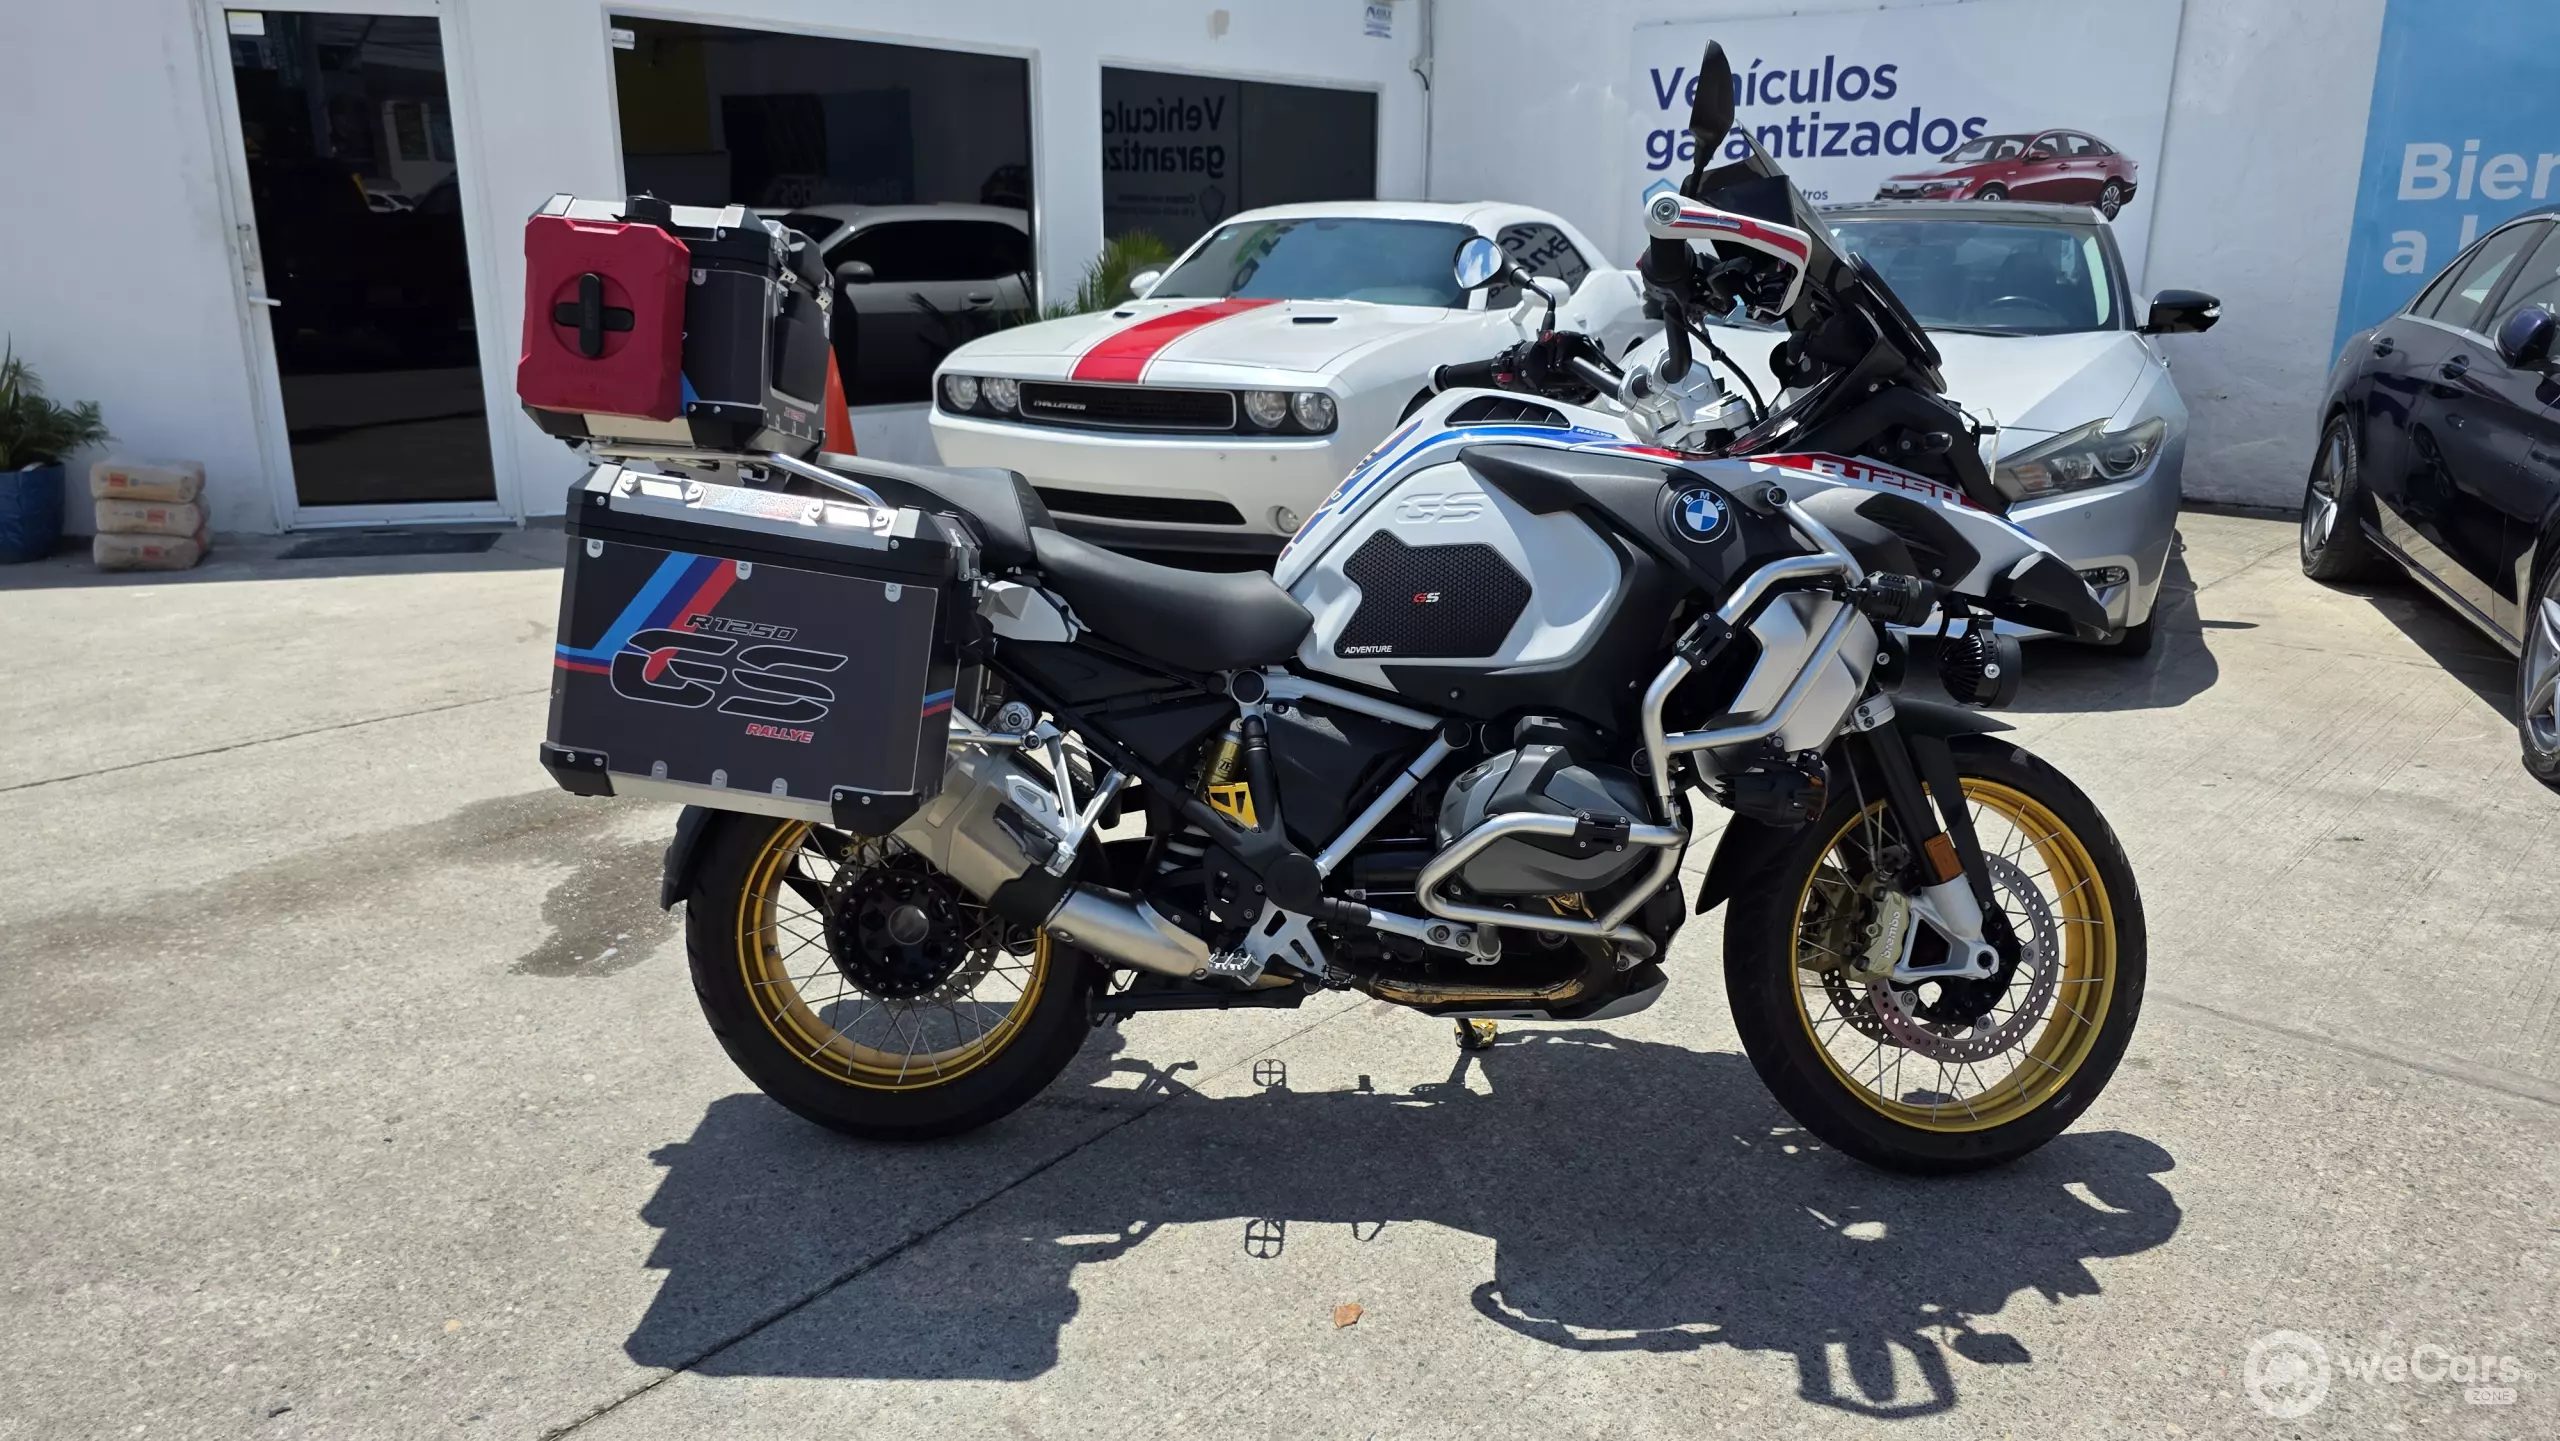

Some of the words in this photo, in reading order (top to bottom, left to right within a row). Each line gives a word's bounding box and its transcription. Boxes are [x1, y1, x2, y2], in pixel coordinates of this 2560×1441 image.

[1645, 106, 1988, 171] gaantizados
[1802, 189, 1829, 201] tros
[2382, 229, 2428, 275] a
[1395, 491, 1487, 525] GS
[1682, 491, 1727, 511] BMW
[1411, 591, 1441, 604] GS
[1344, 644, 1393, 655] ADVENTURE
[609, 627, 849, 724] GS
[745, 722, 815, 744] RALLYE
[1880, 911, 1901, 959] brembo
